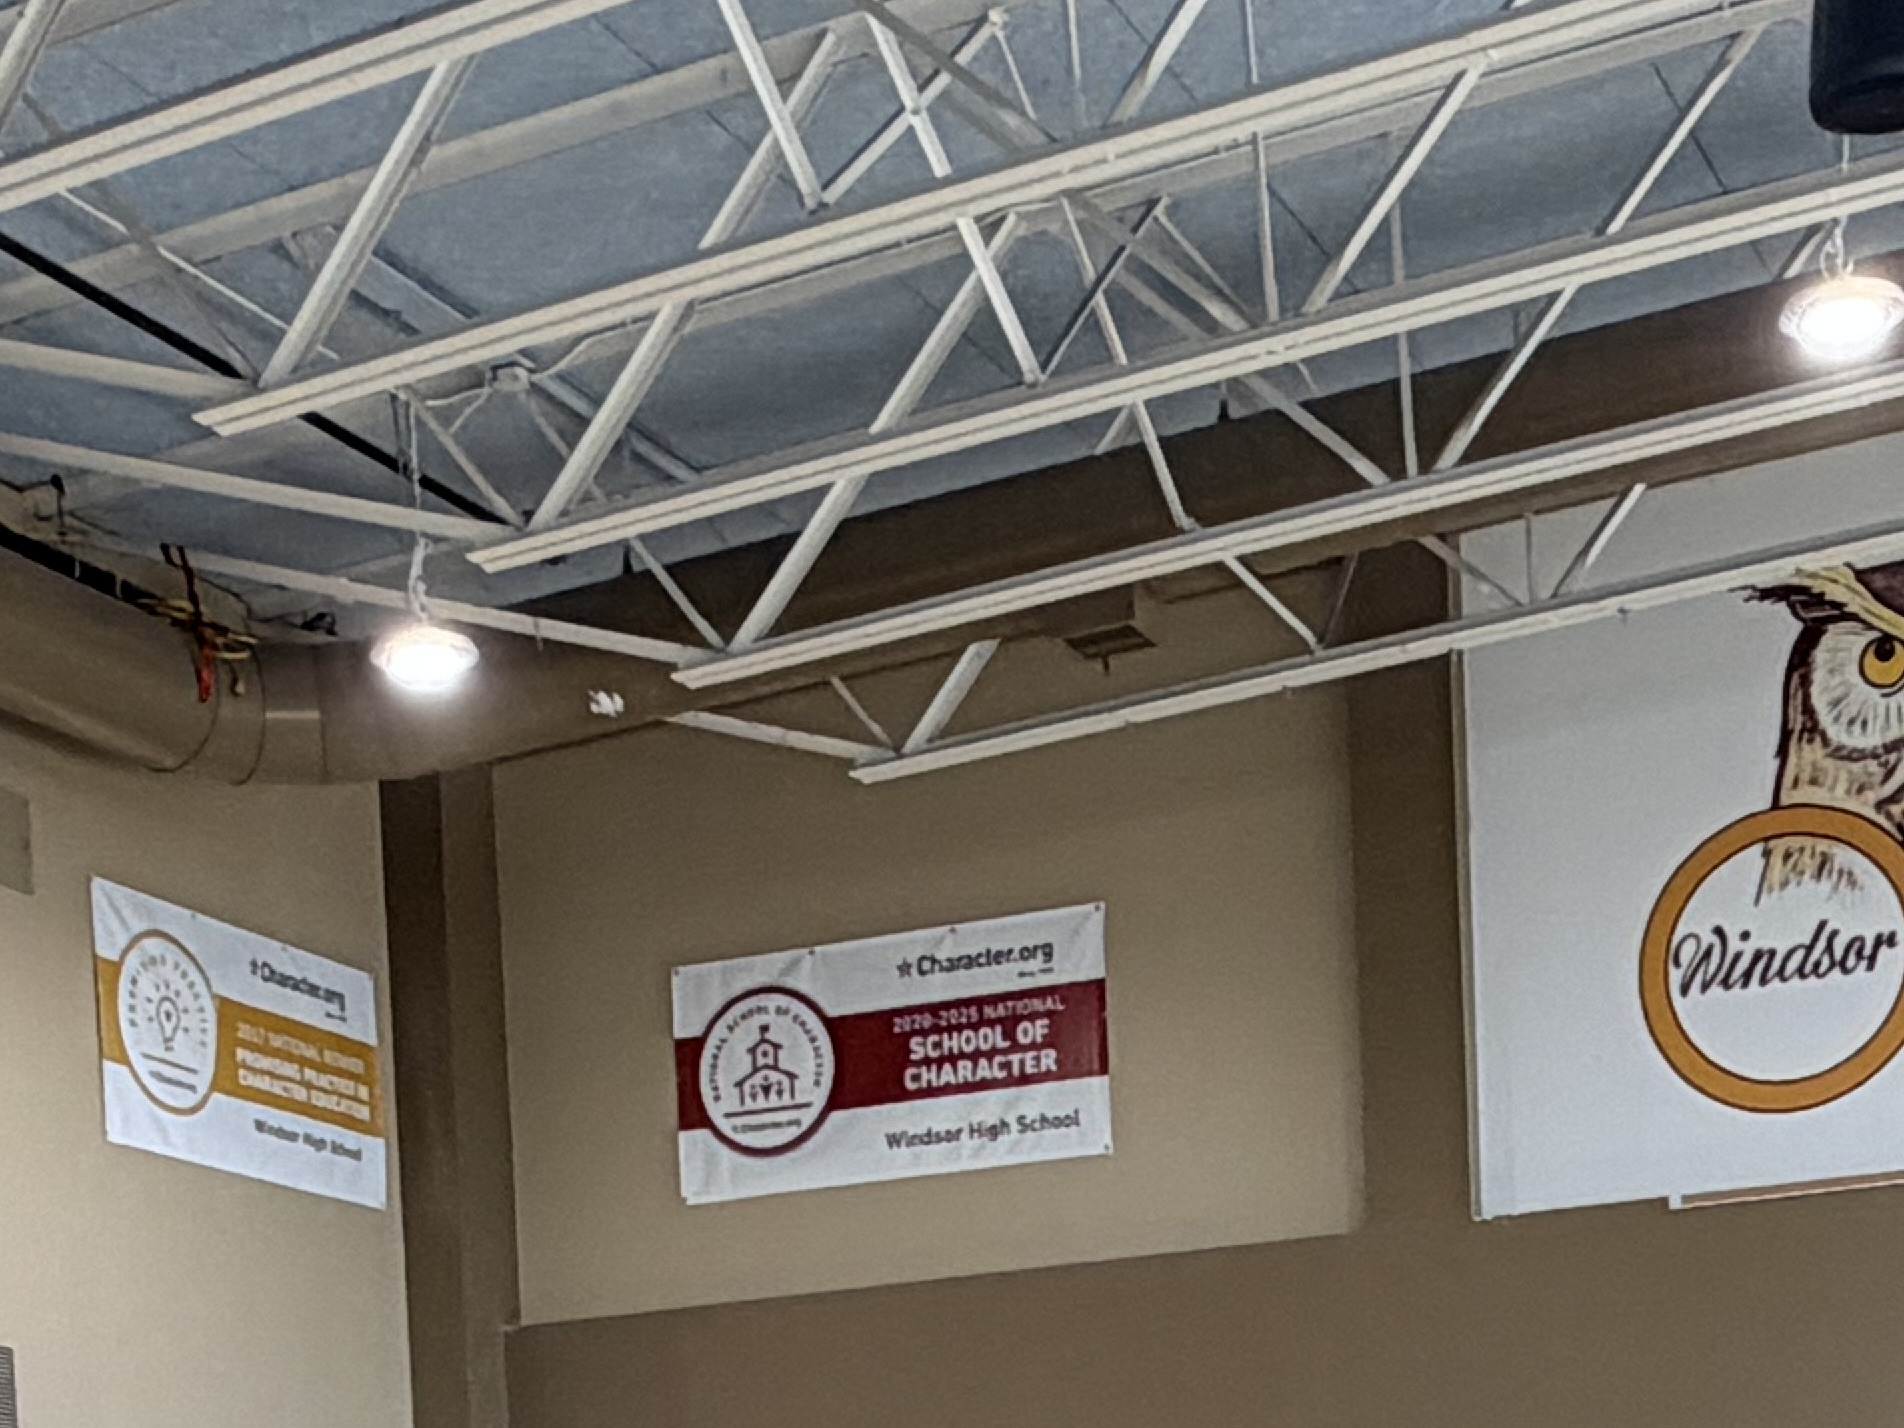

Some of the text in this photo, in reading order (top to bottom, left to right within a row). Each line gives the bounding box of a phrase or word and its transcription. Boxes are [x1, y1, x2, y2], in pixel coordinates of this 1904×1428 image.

[916, 942, 1054, 976] Character.org
[1671, 920, 1899, 998] Windsor
[983, 994, 1065, 1019] NATIONAL
[909, 1018, 1050, 1060] SCHOOL OF
[904, 1048, 1058, 1090] CHARACTER
[885, 1107, 1080, 1149] Windsor High School
